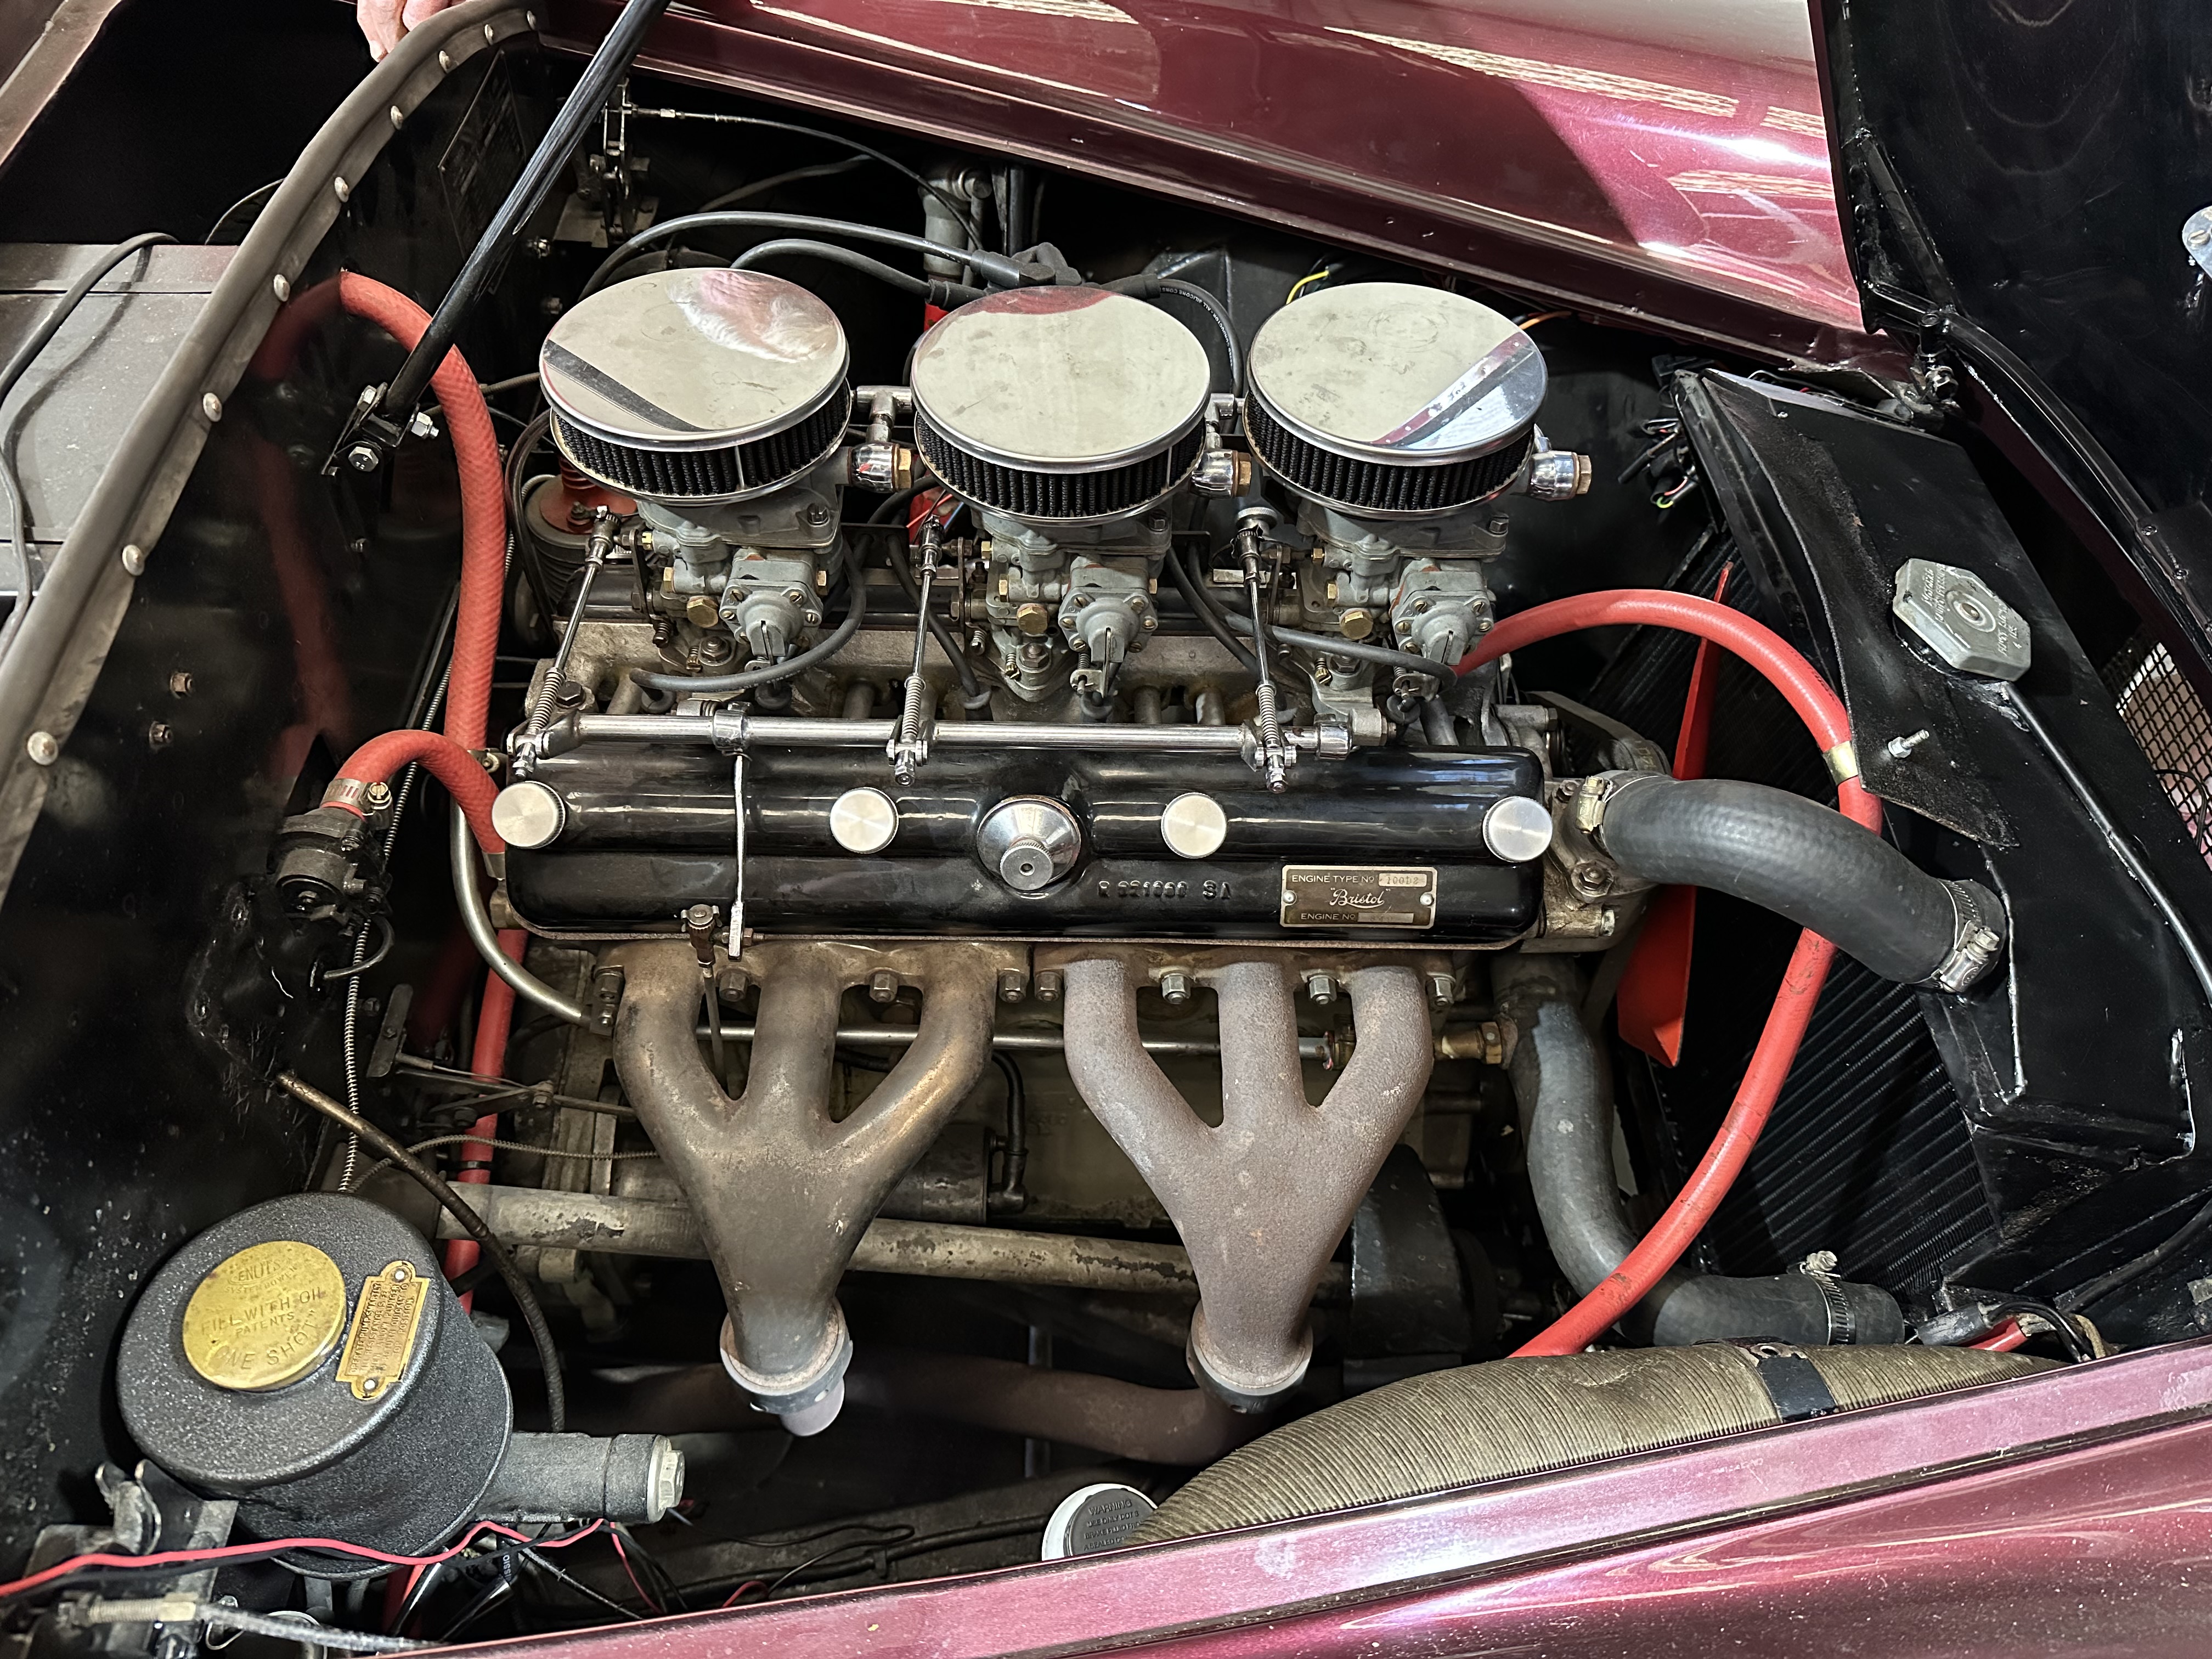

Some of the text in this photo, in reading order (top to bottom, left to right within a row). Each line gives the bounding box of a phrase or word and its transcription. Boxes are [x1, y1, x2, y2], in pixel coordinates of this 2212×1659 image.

[1203, 879, 1231, 900] SA
[201, 1286, 323, 1335] FILL WITH OIL
[377, 1322, 390, 1350] ALLOW
[385, 1283, 401, 1318] PLUNGER
[391, 1295, 406, 1326] QUICKLY
[400, 1283, 409, 1293] TO
[235, 1311, 295, 1338] PATENTS
[349, 1282, 382, 1374] OPERATE PUMP SMARTLY
[365, 1309, 383, 1356] RESISTANCE
[392, 1341, 402, 1356] TOP
[1088, 1499, 1133, 1515] WARNING
[1087, 1518, 1101, 1527] USE
[1102, 1514, 1119, 1525] ONLY
[1120, 1512, 1134, 1521] DOT
[1084, 1529, 1107, 1539] BRAKE
[1108, 1525, 1126, 1534] FLUID
[1090, 1539, 1114, 1549] SEALED
